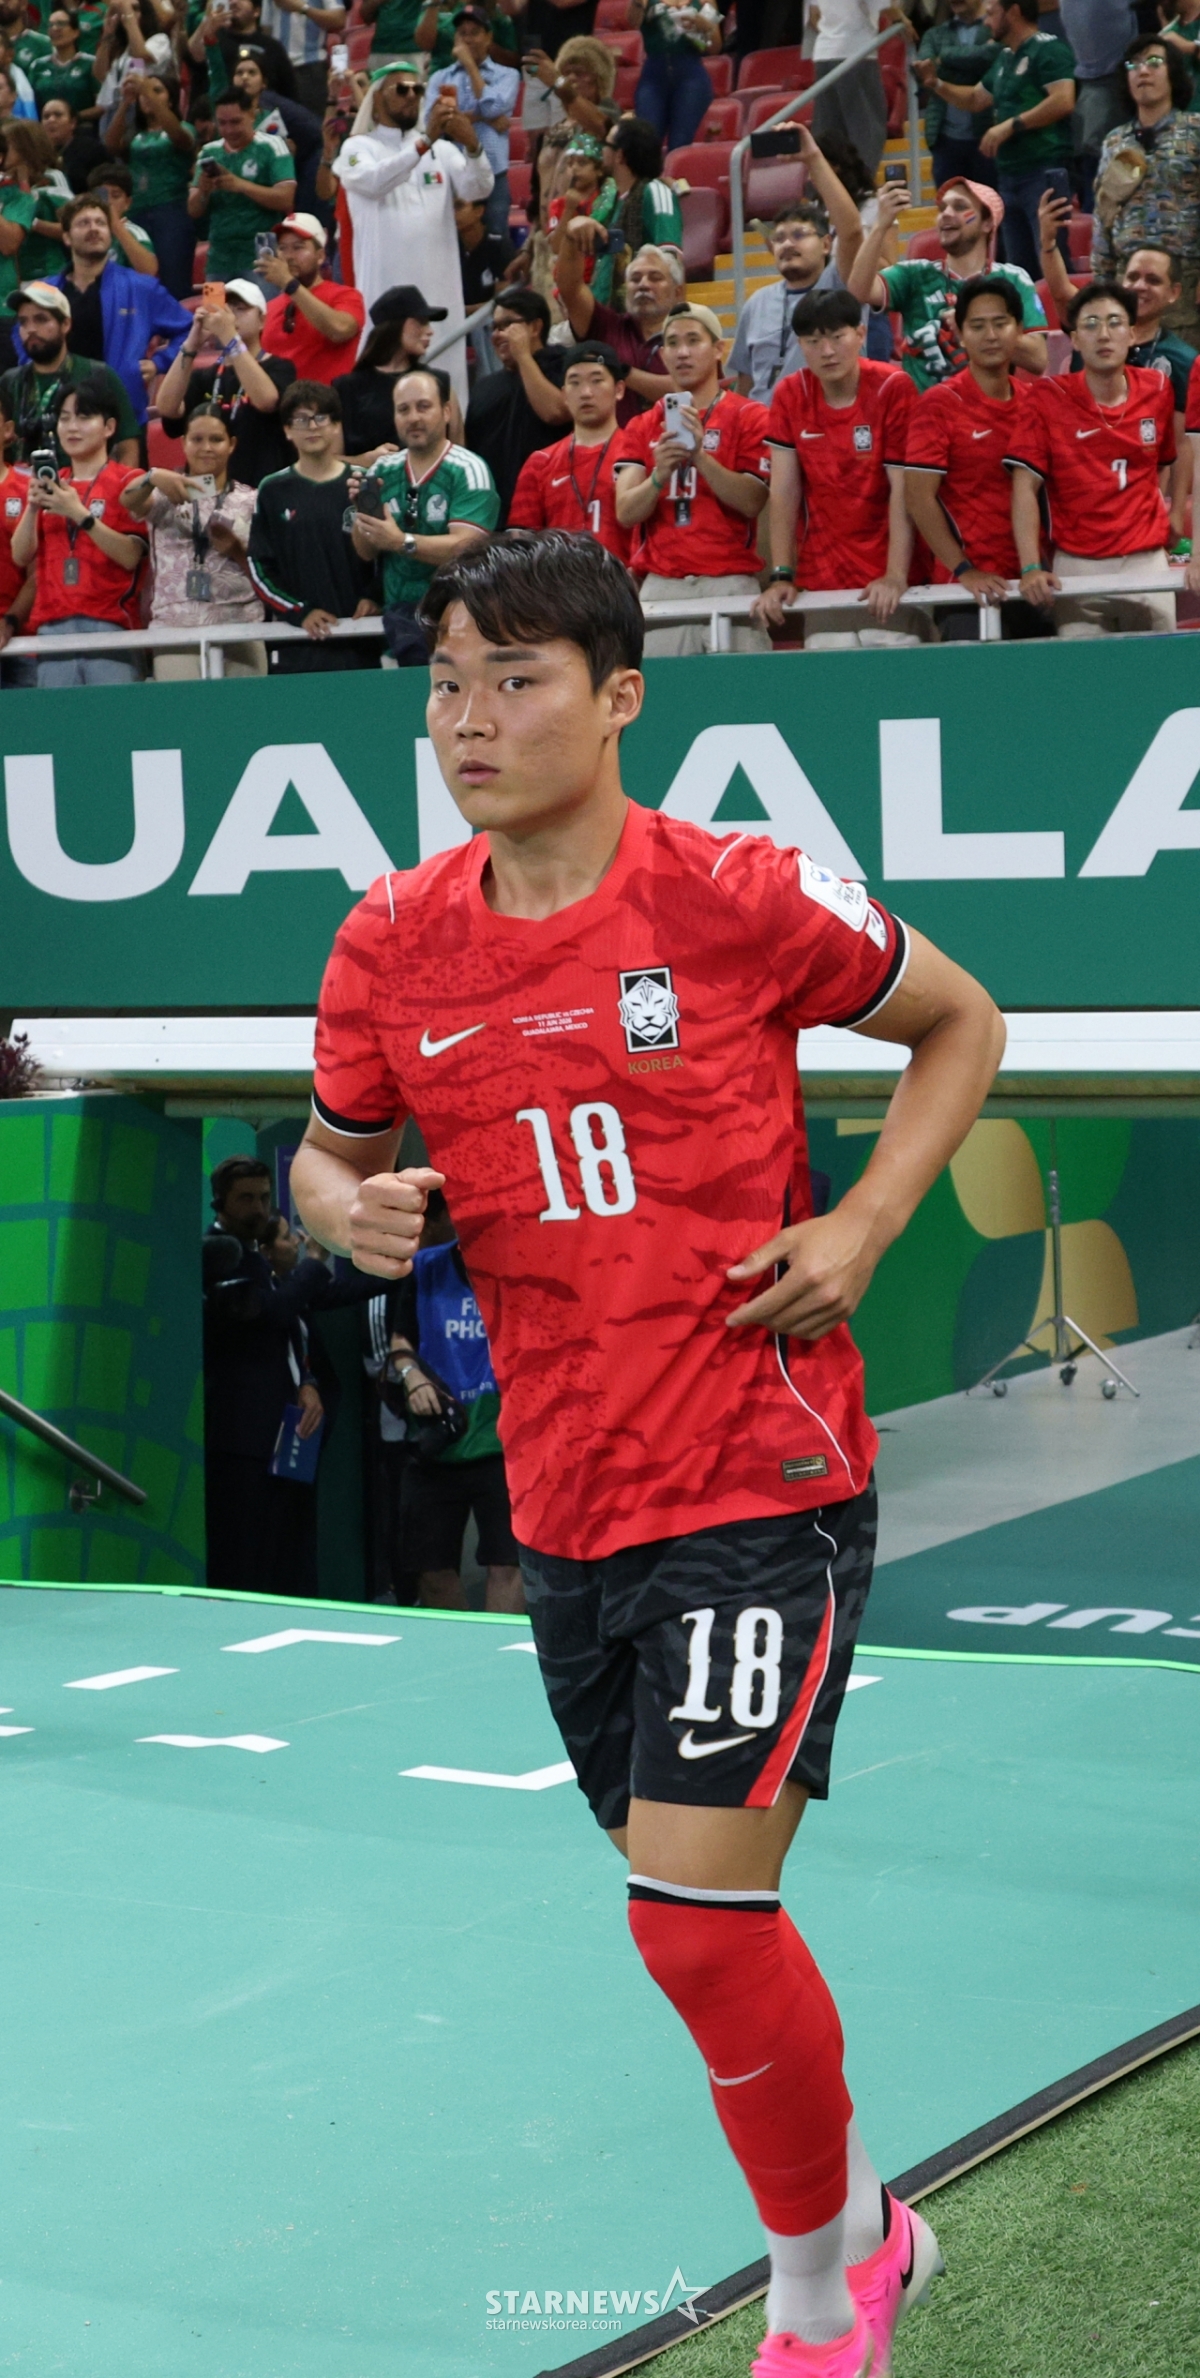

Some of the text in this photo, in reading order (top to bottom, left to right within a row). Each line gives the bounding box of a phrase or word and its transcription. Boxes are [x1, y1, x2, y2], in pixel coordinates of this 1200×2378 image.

[664, 466, 697, 499] 19
[1111, 459, 1128, 490] 7
[512, 1015, 534, 1024] KOREA
[533, 1012, 562, 1021] REPUBLIC
[569, 1007, 595, 1017] CZECHIA
[537, 1020, 546, 1028] 11
[546, 1019, 558, 1027] JUN
[564, 1022, 589, 1031] MEXICO
[628, 1054, 684, 1075] KOREA
[515, 1101, 637, 1224] 18
[668, 1607, 784, 1728] 18
